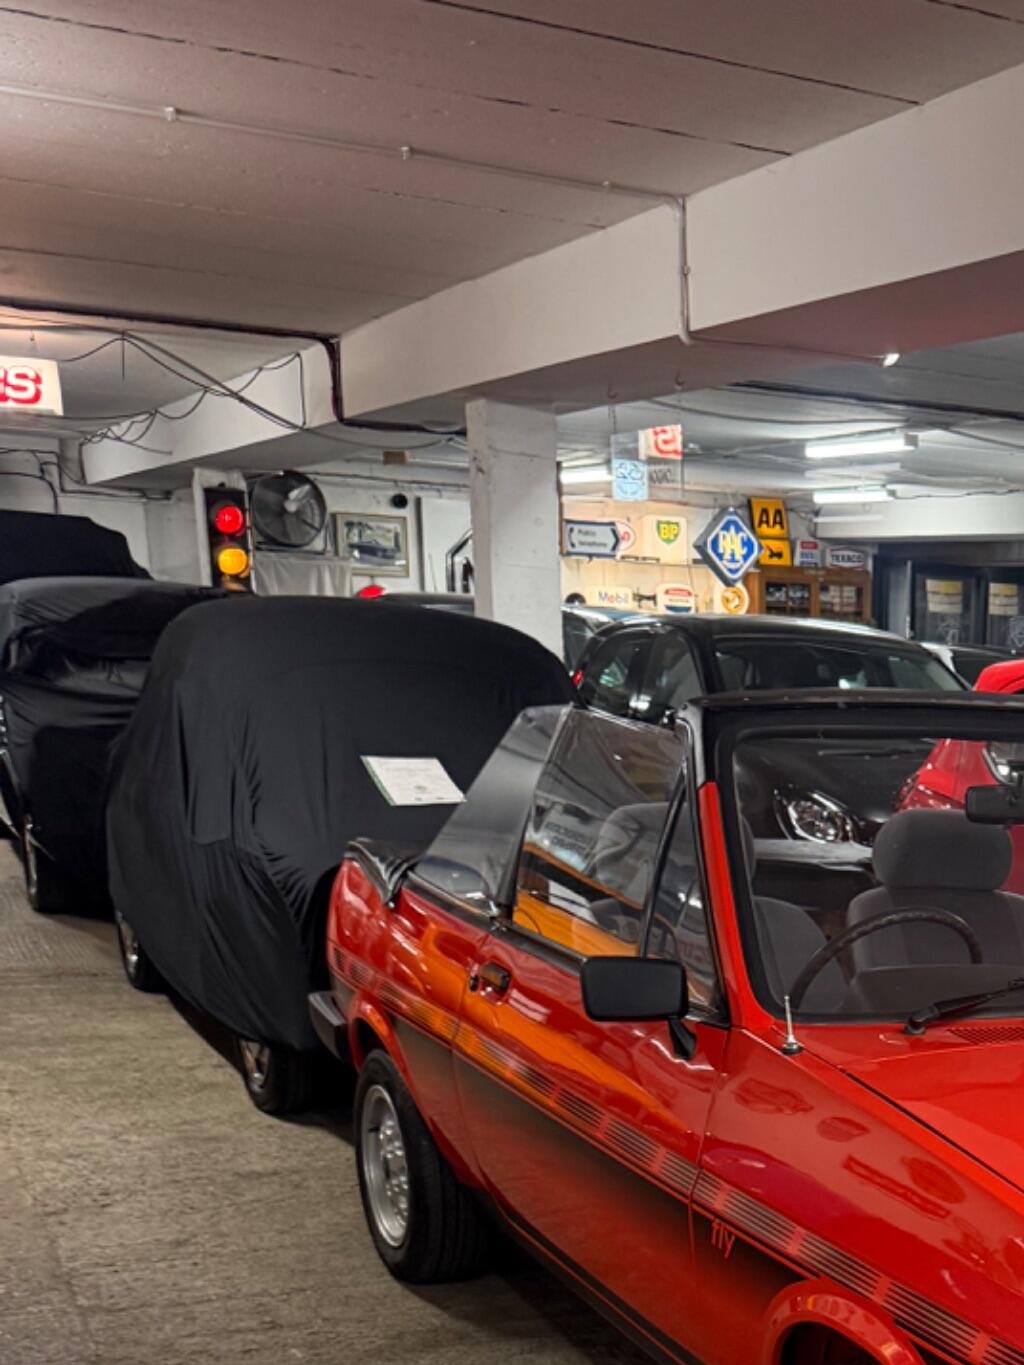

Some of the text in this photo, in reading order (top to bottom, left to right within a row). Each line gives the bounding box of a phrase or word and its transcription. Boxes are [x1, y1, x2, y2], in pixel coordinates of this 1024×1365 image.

[757, 508, 784, 529] AA
[660, 524, 679, 538] BP
[718, 524, 748, 560] RAC
